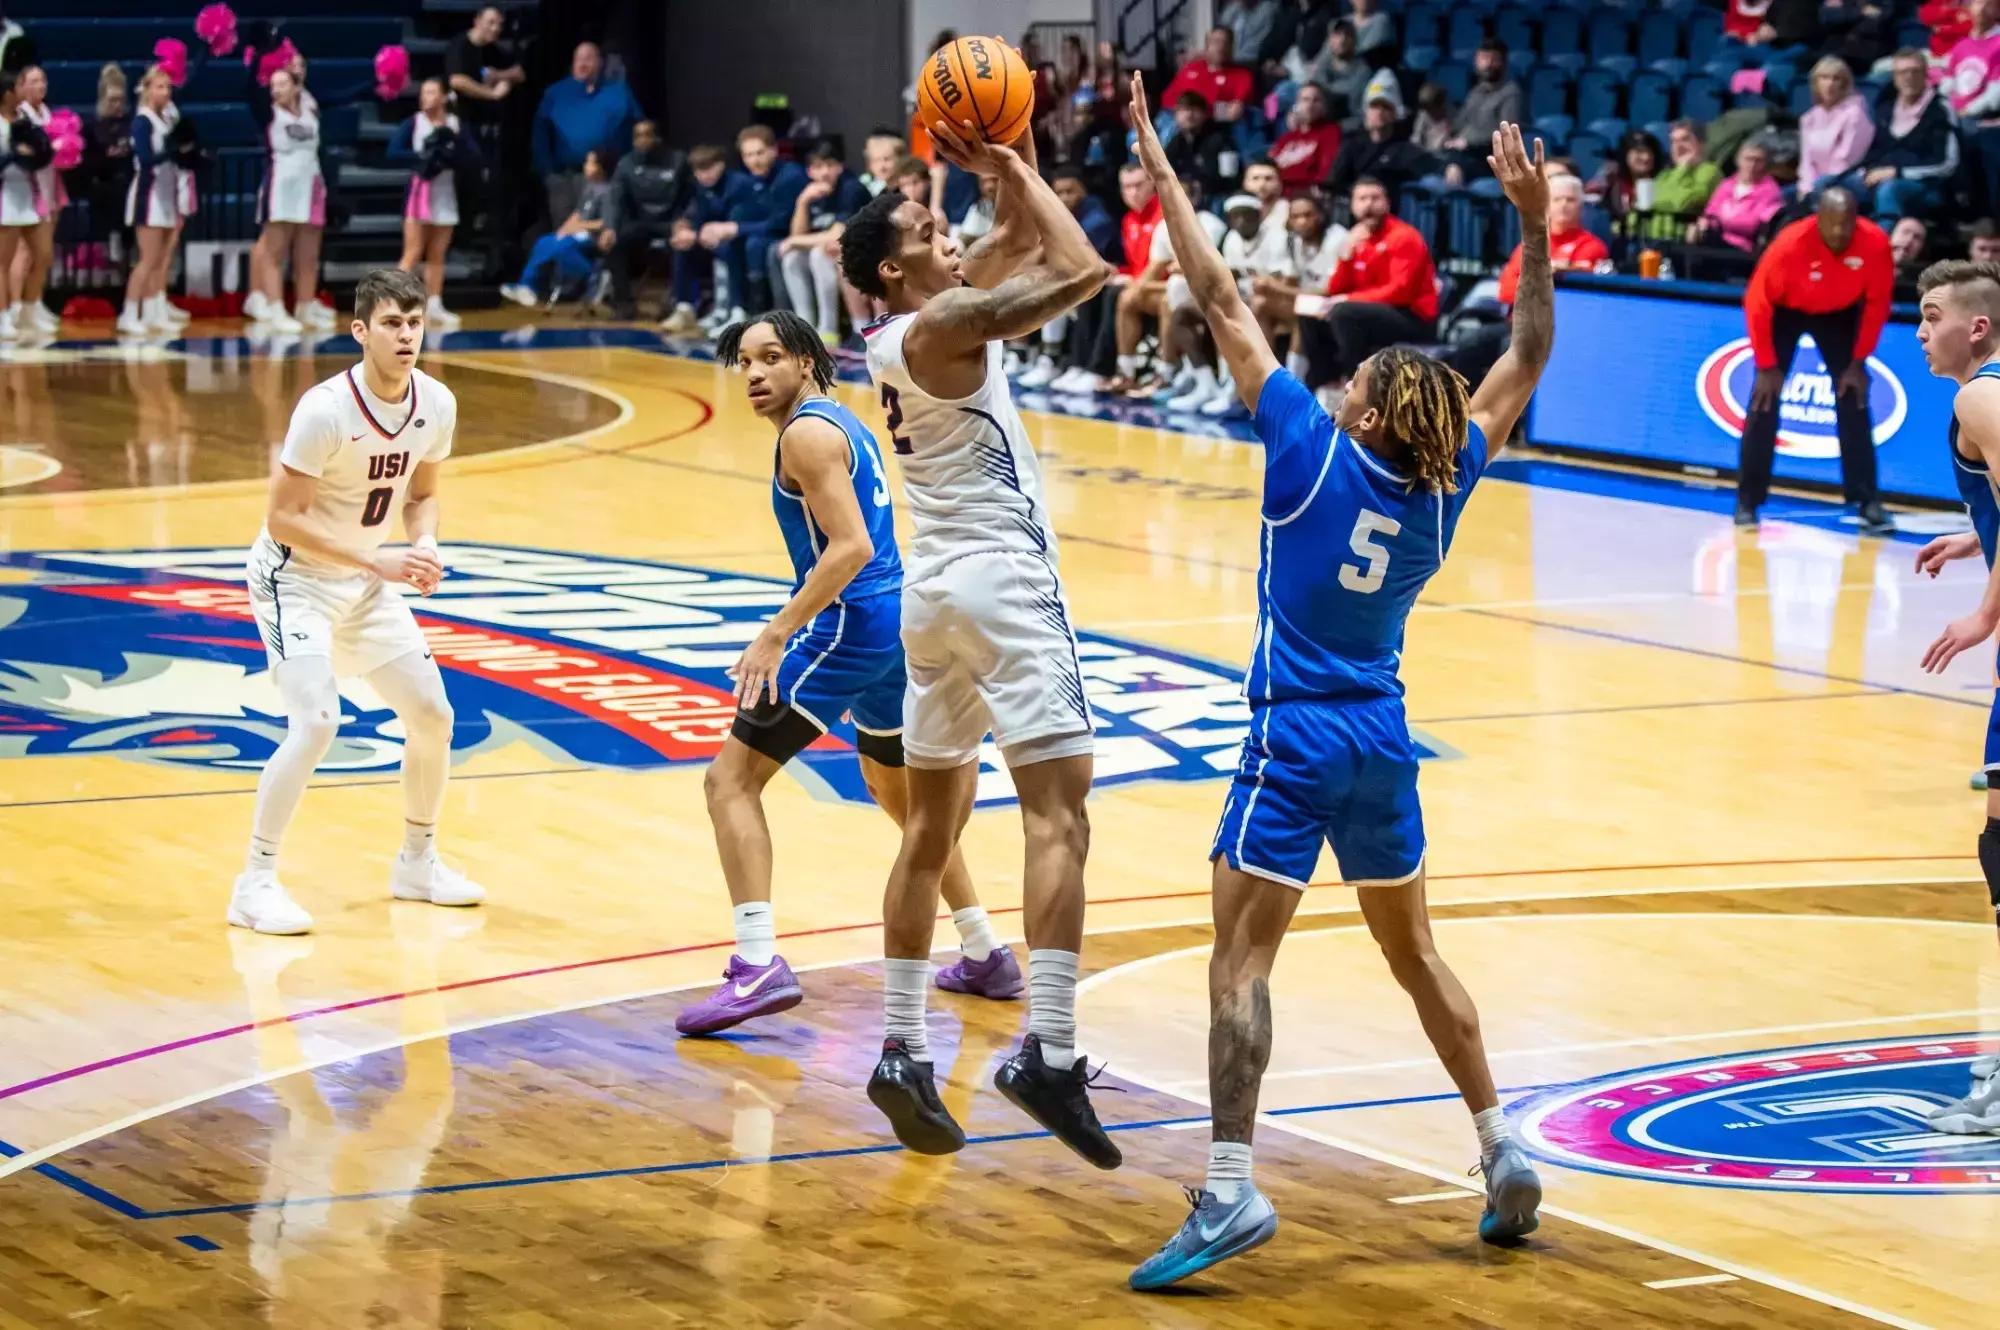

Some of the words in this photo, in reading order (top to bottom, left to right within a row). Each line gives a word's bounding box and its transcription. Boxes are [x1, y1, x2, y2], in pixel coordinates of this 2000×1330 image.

[967, 39, 993, 80] NCAA
[880, 381, 915, 455] 2
[367, 450, 410, 481] USI
[360, 486, 394, 528] 0
[1337, 507, 1402, 594] 5
[531, 672, 739, 743] EAGLES
